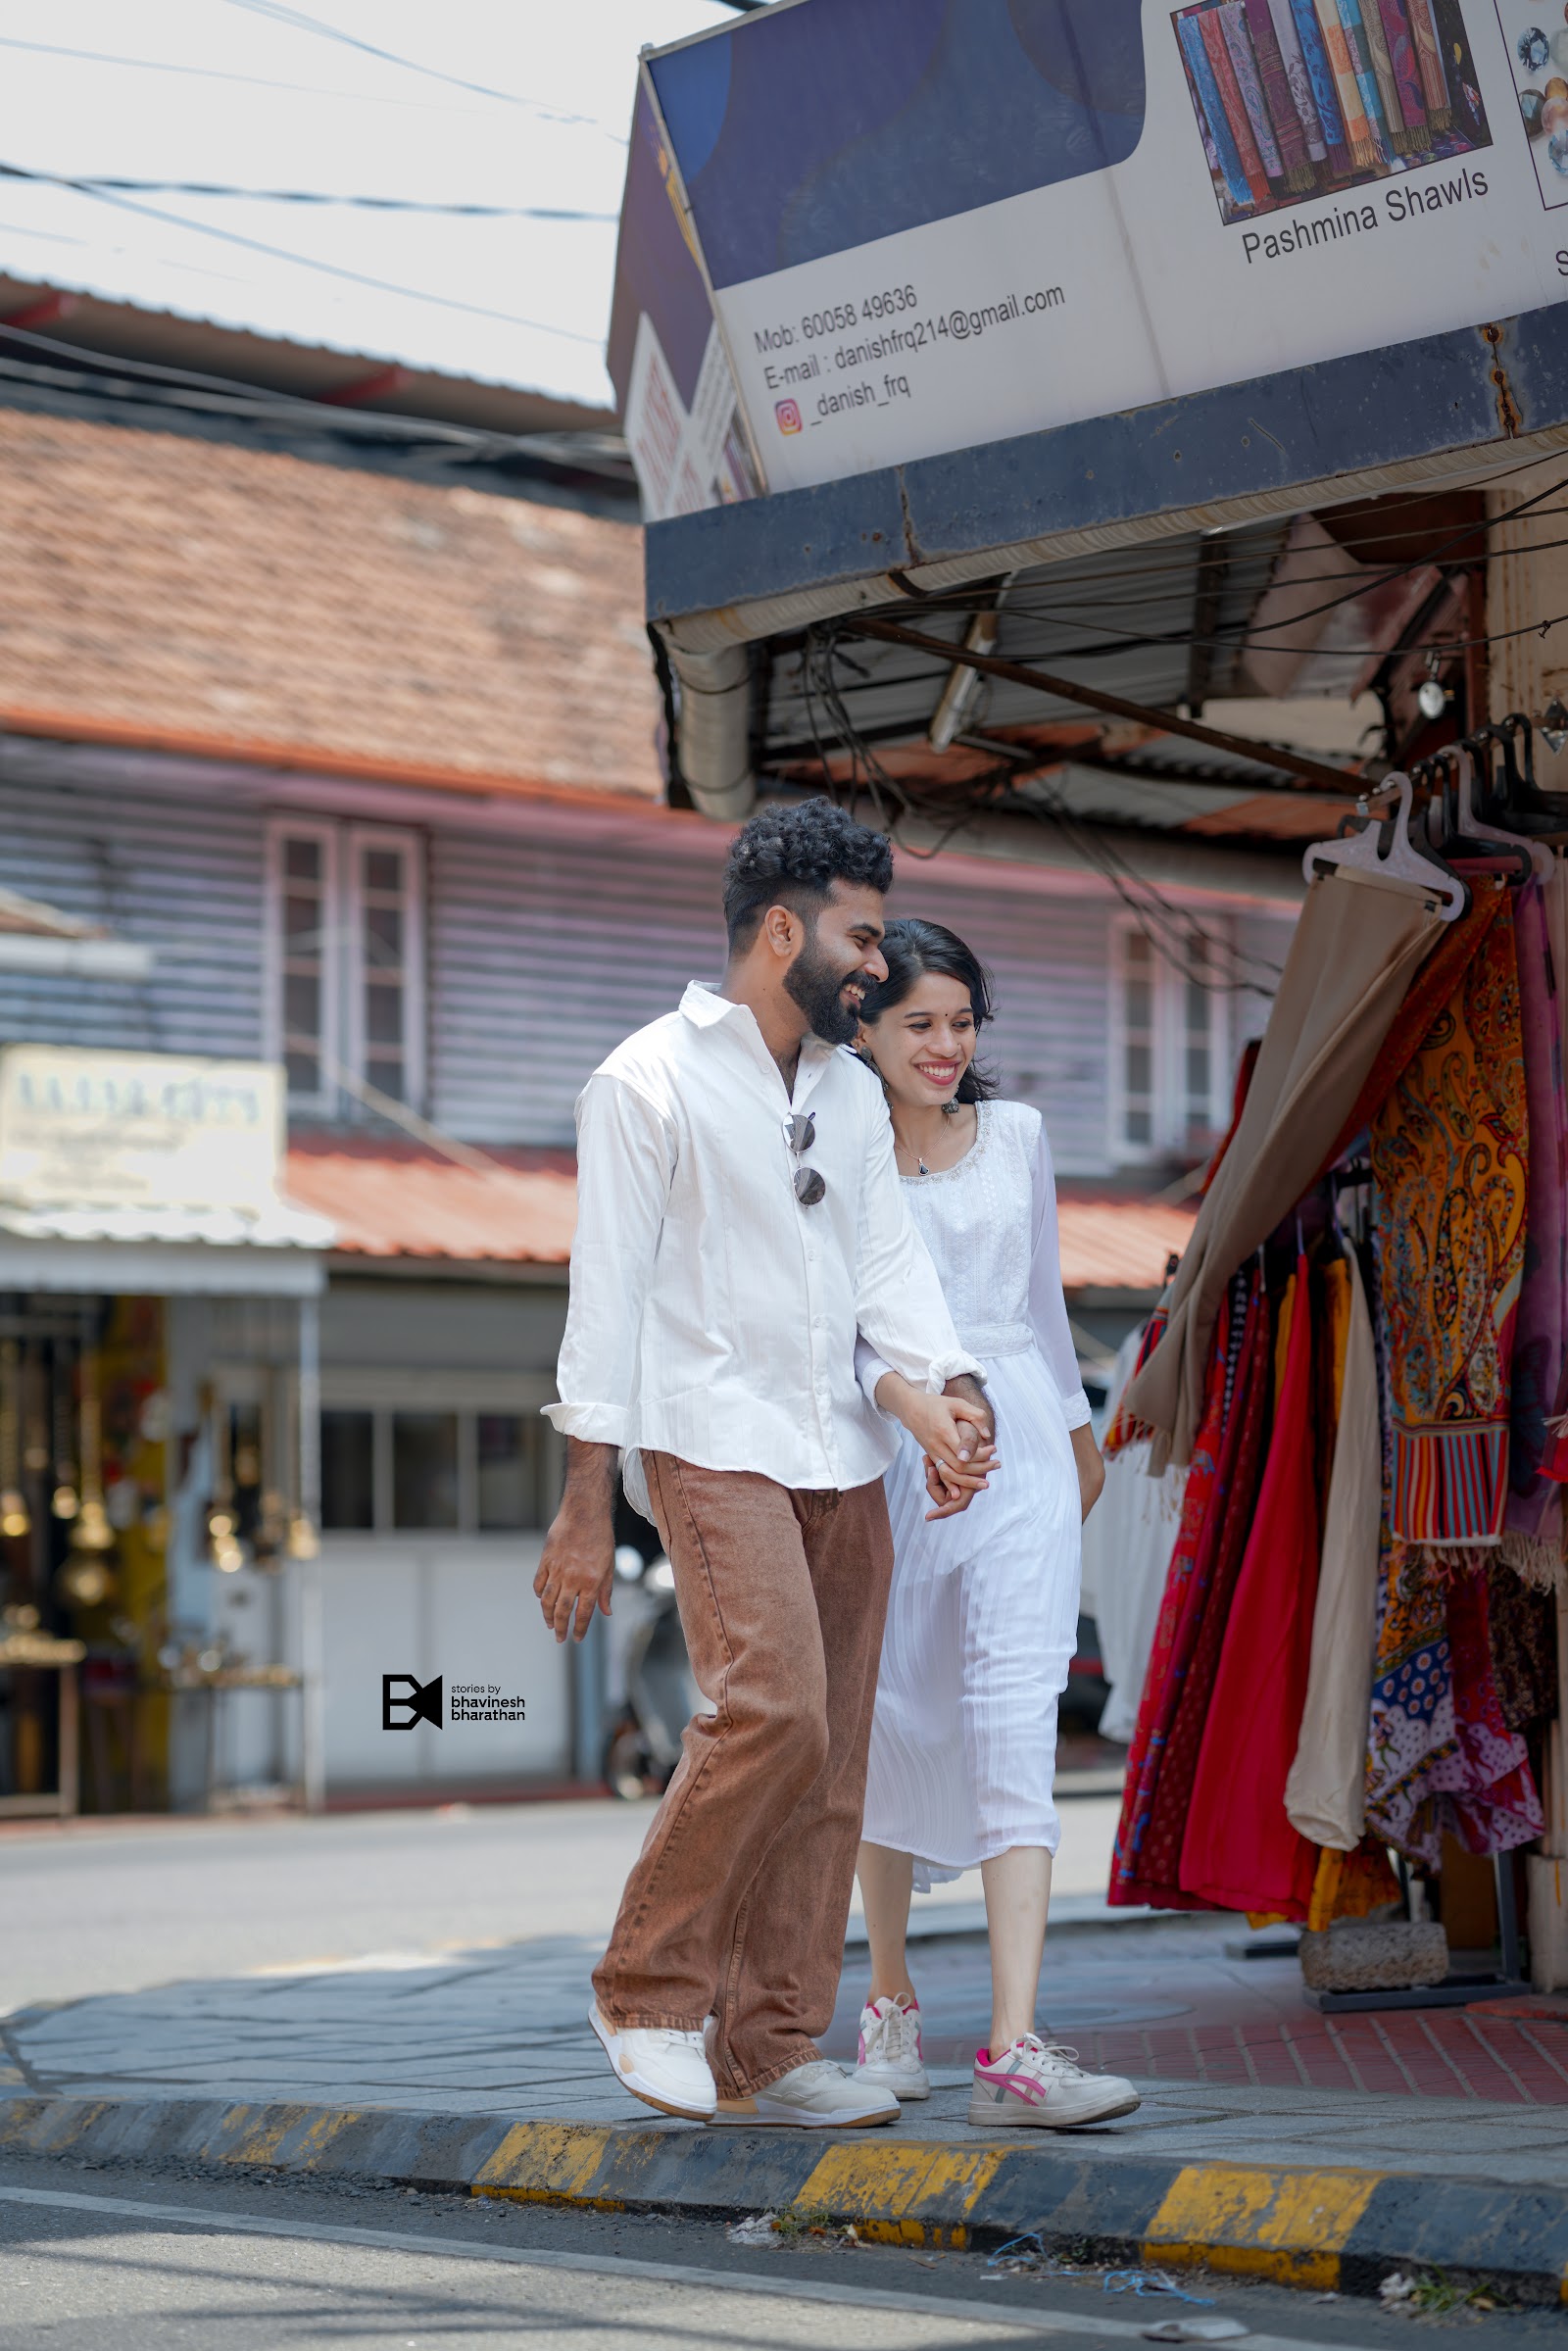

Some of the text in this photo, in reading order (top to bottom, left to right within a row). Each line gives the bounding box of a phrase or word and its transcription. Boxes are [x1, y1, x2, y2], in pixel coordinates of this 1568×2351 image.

[1242, 168, 1489, 264] Pashmina Shawls
[754, 284, 918, 354] Mob: 60058 49636
[764, 354, 821, 390] E-mail
[835, 285, 1066, 369] danishfrq214@gmail.com
[809, 373, 911, 426] _danish_frq
